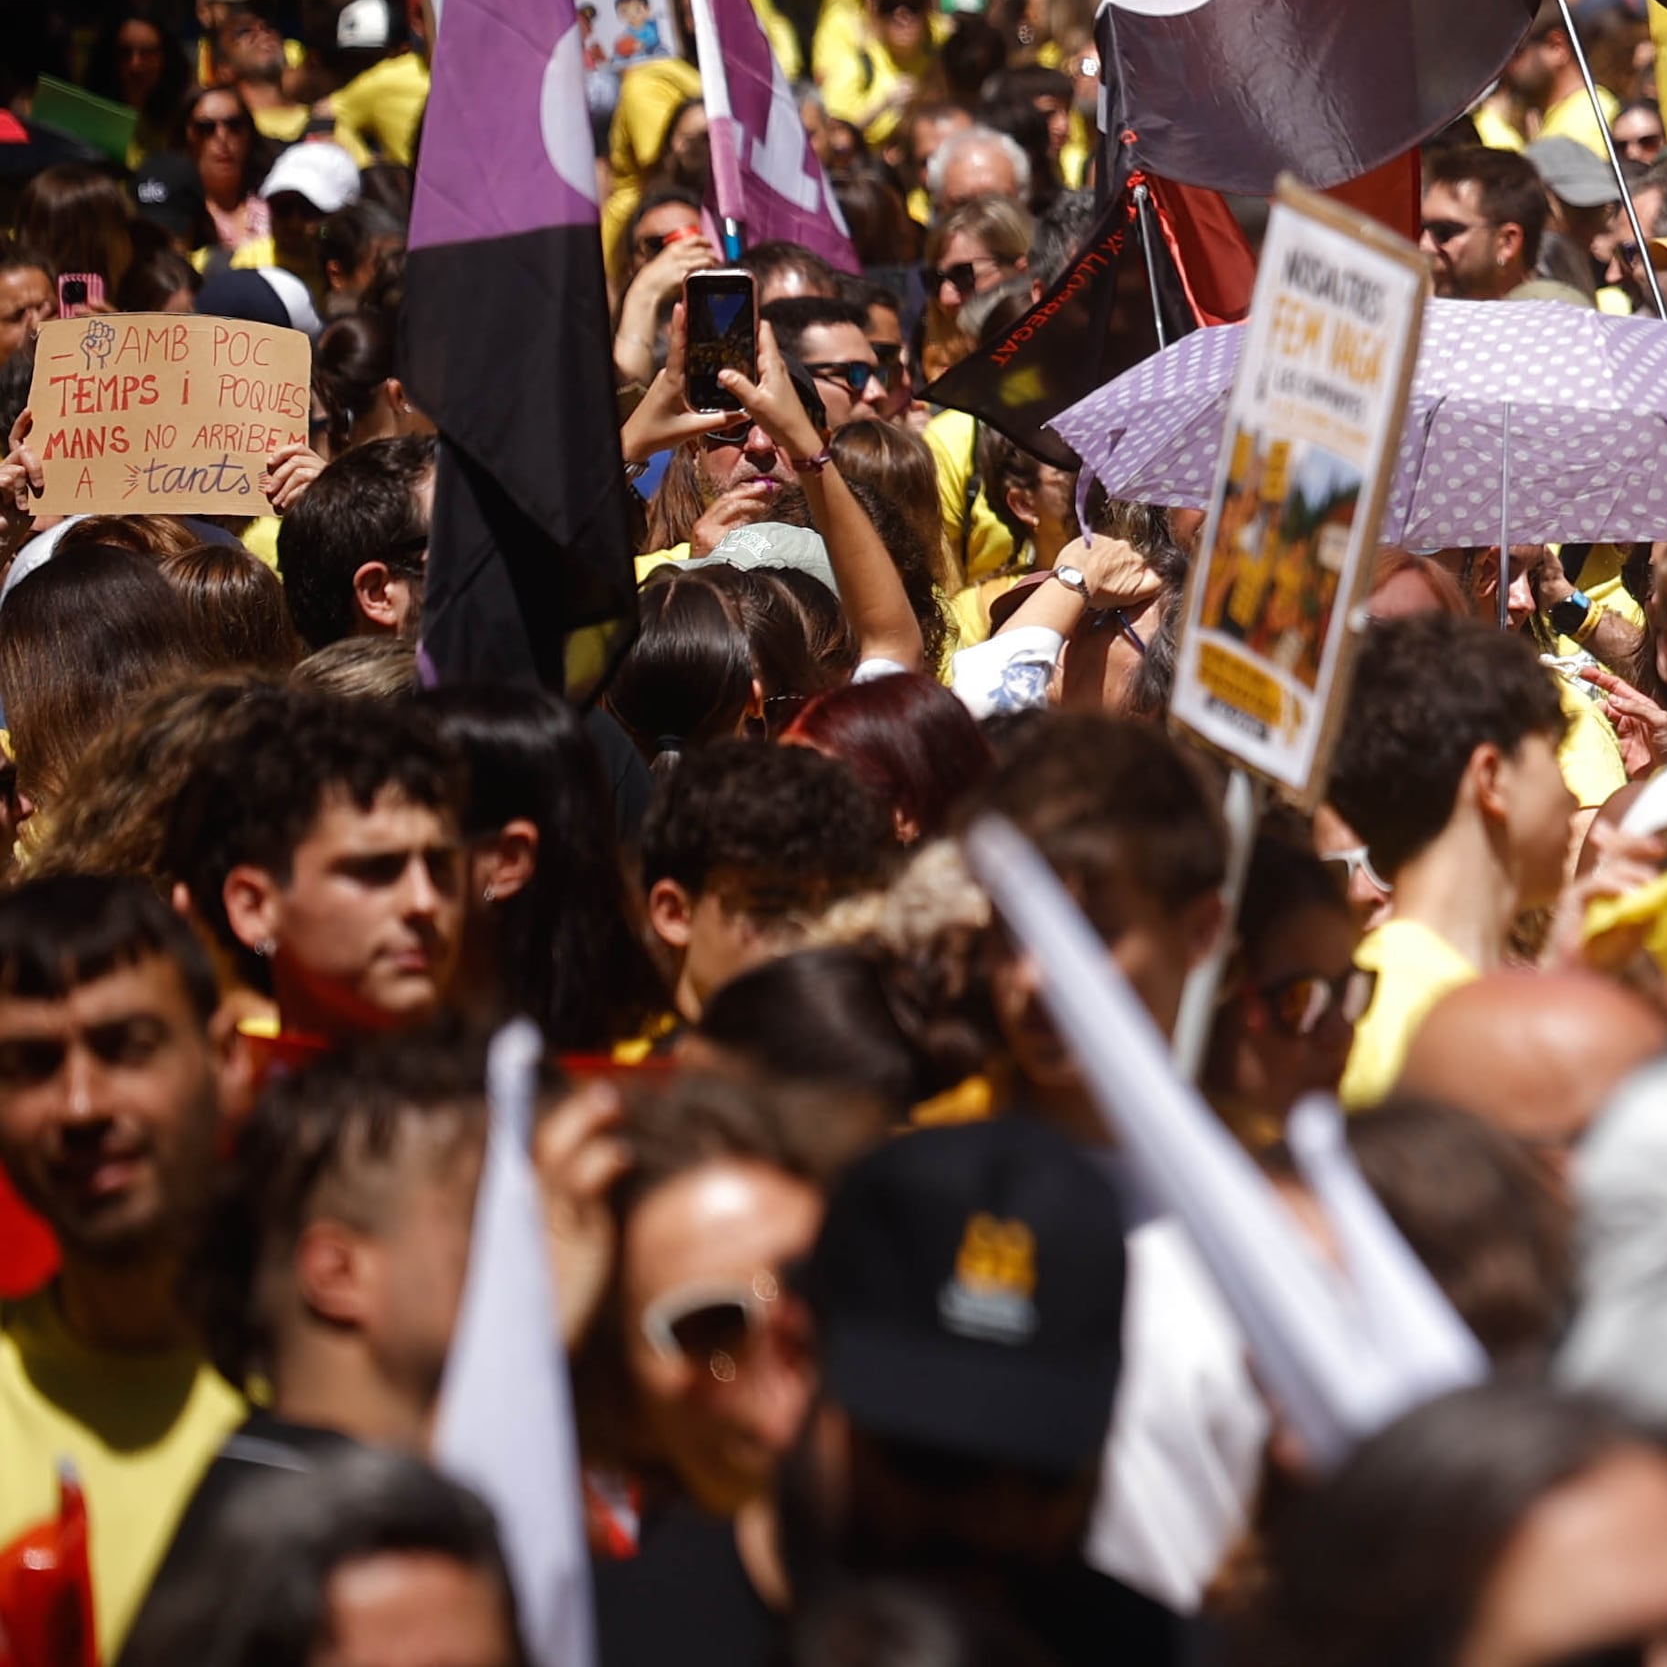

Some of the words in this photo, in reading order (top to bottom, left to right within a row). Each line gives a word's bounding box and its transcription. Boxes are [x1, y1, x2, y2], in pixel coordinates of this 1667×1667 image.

[115, 324, 190, 365] AMB
[213, 325, 274, 367] POC
[49, 372, 160, 417] TEMPS
[218, 374, 306, 419] POQUES
[42, 425, 131, 460] MANS
[144, 424, 177, 452] NO
[75, 466, 94, 499] A
[142, 453, 251, 495] tants
